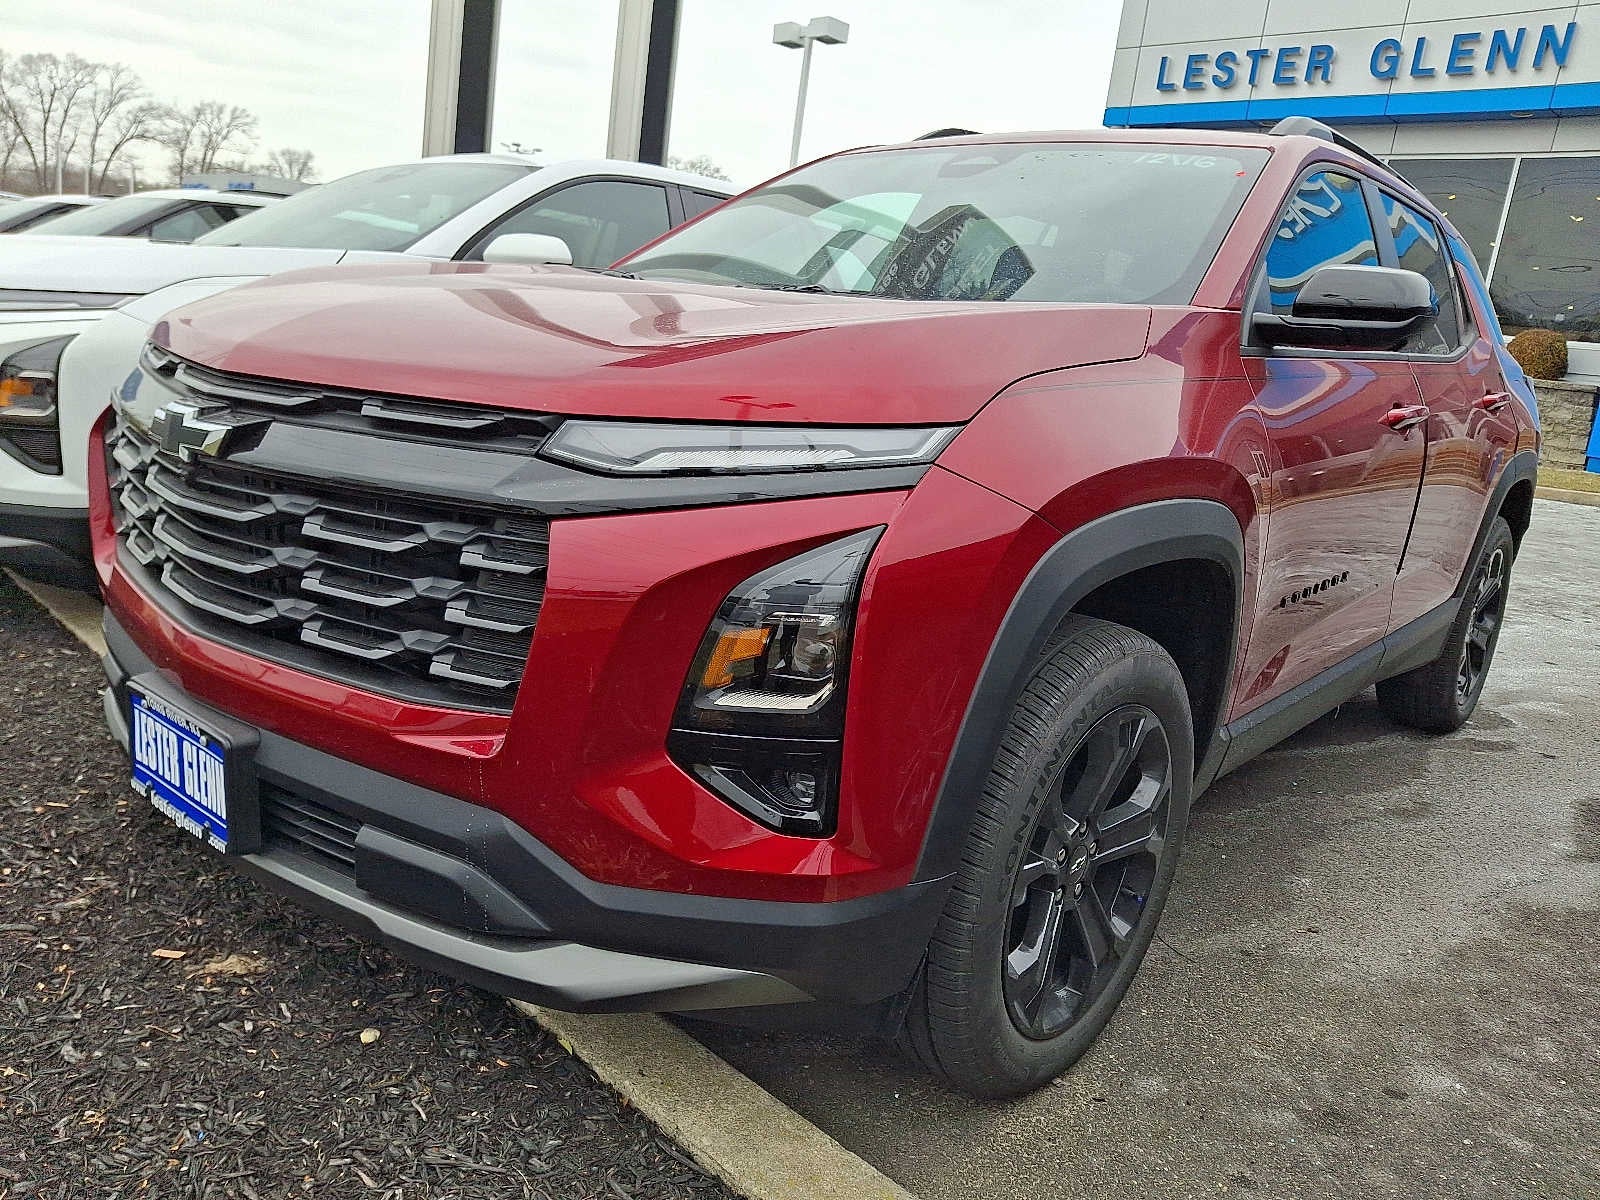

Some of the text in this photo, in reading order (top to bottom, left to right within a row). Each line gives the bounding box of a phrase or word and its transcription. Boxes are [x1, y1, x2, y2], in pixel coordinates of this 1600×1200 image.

[1156, 21, 1578, 92] LESTER GLENN
[134, 708, 227, 820] LESTER GLENN
